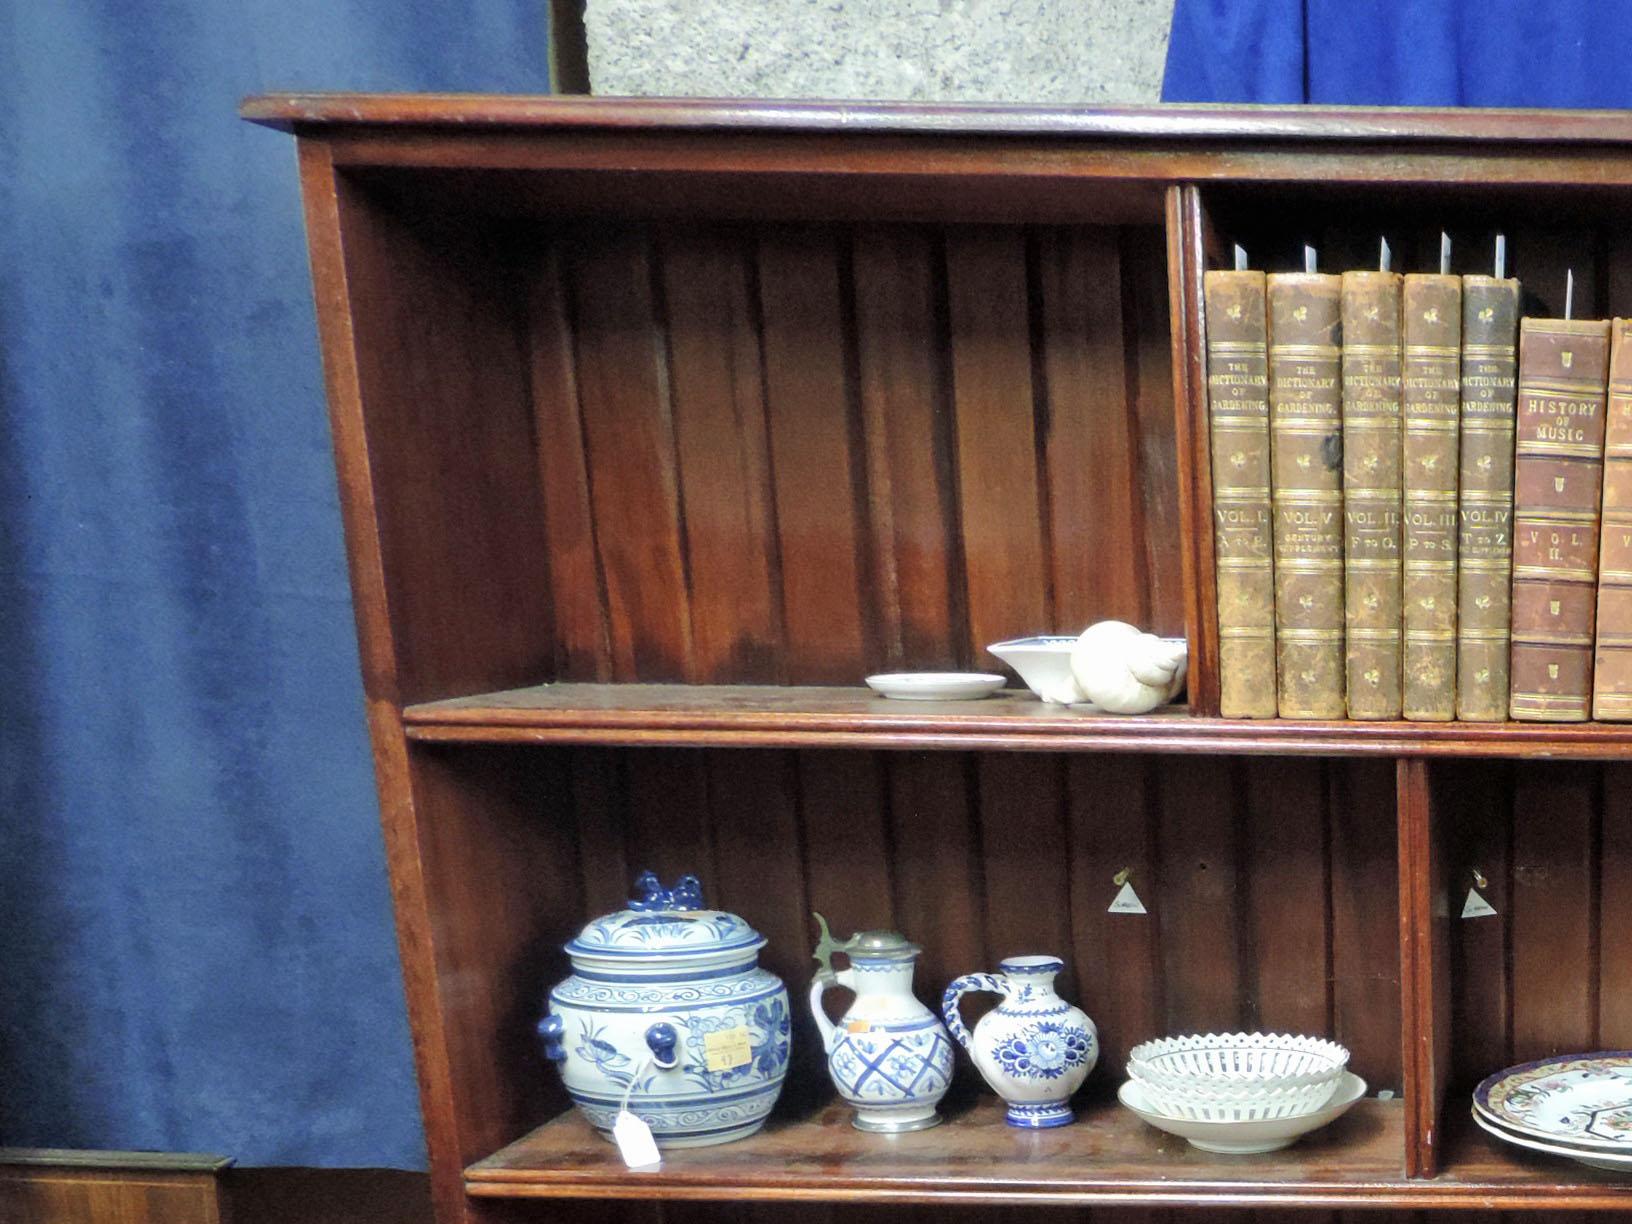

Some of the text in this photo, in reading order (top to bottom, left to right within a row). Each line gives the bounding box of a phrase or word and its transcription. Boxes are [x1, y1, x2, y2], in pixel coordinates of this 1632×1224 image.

[1228, 363, 1248, 373] THE
[1296, 366, 1316, 375] THE
[1364, 364, 1383, 373] THE
[1423, 366, 1443, 375] THE
[1479, 364, 1498, 373] THE
[1210, 374, 1266, 385] DICTIONARY
[1277, 378, 1335, 388] DICTIONARY
[1344, 376, 1400, 386] DICTIONARY
[1232, 387, 1246, 396] OF
[1300, 391, 1313, 399] OF
[1425, 391, 1438, 400] OF
[1480, 389, 1494, 398] OF
[1277, 402, 1337, 414] GARDENING.
[1528, 400, 1597, 416] HISTORY
[1556, 416, 1570, 427] OF
[1536, 428, 1584, 441] MUSIC
[1351, 537, 1360, 549] F
[1462, 532, 1473, 545] T
[1409, 538, 1419, 550] P
[1549, 548, 1564, 561] II.
